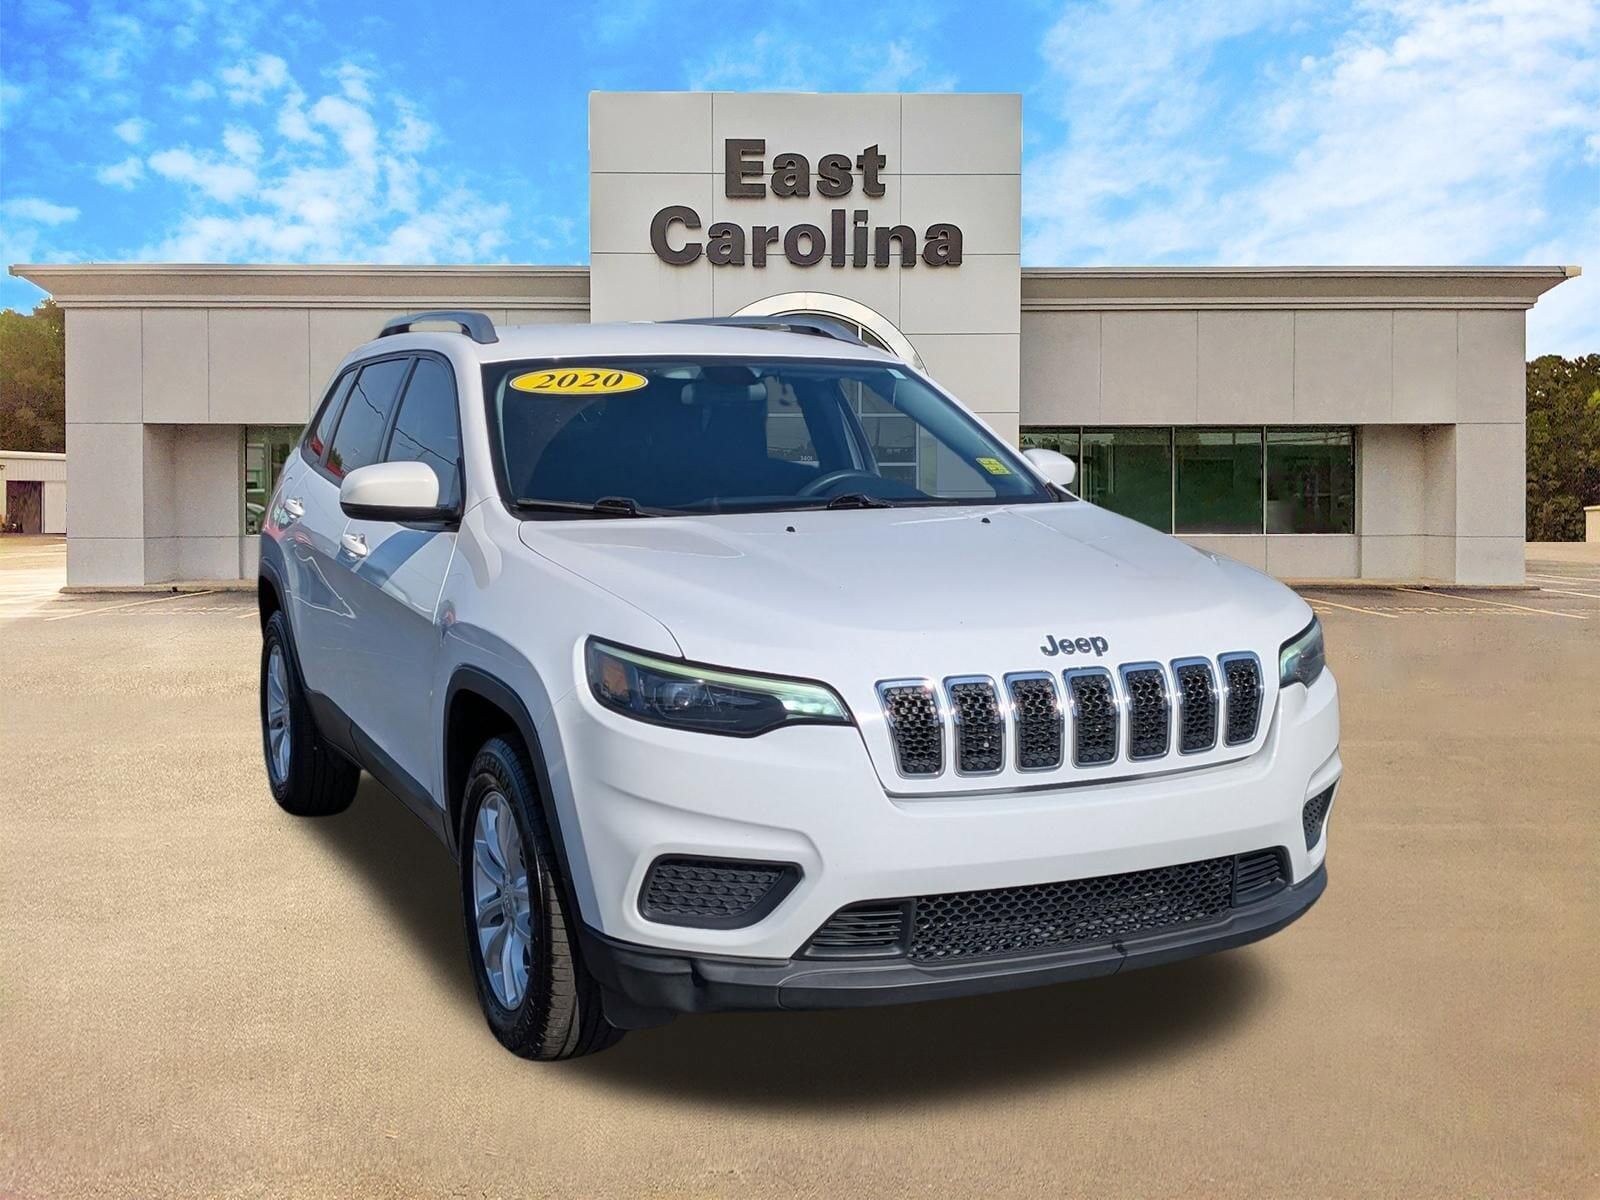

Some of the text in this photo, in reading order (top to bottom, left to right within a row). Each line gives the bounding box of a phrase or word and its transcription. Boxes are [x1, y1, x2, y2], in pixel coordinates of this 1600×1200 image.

[724, 138, 886, 198] East
[650, 205, 963, 268] Carolina
[532, 372, 624, 389] 2020
[1040, 634, 1109, 657] Jeep
